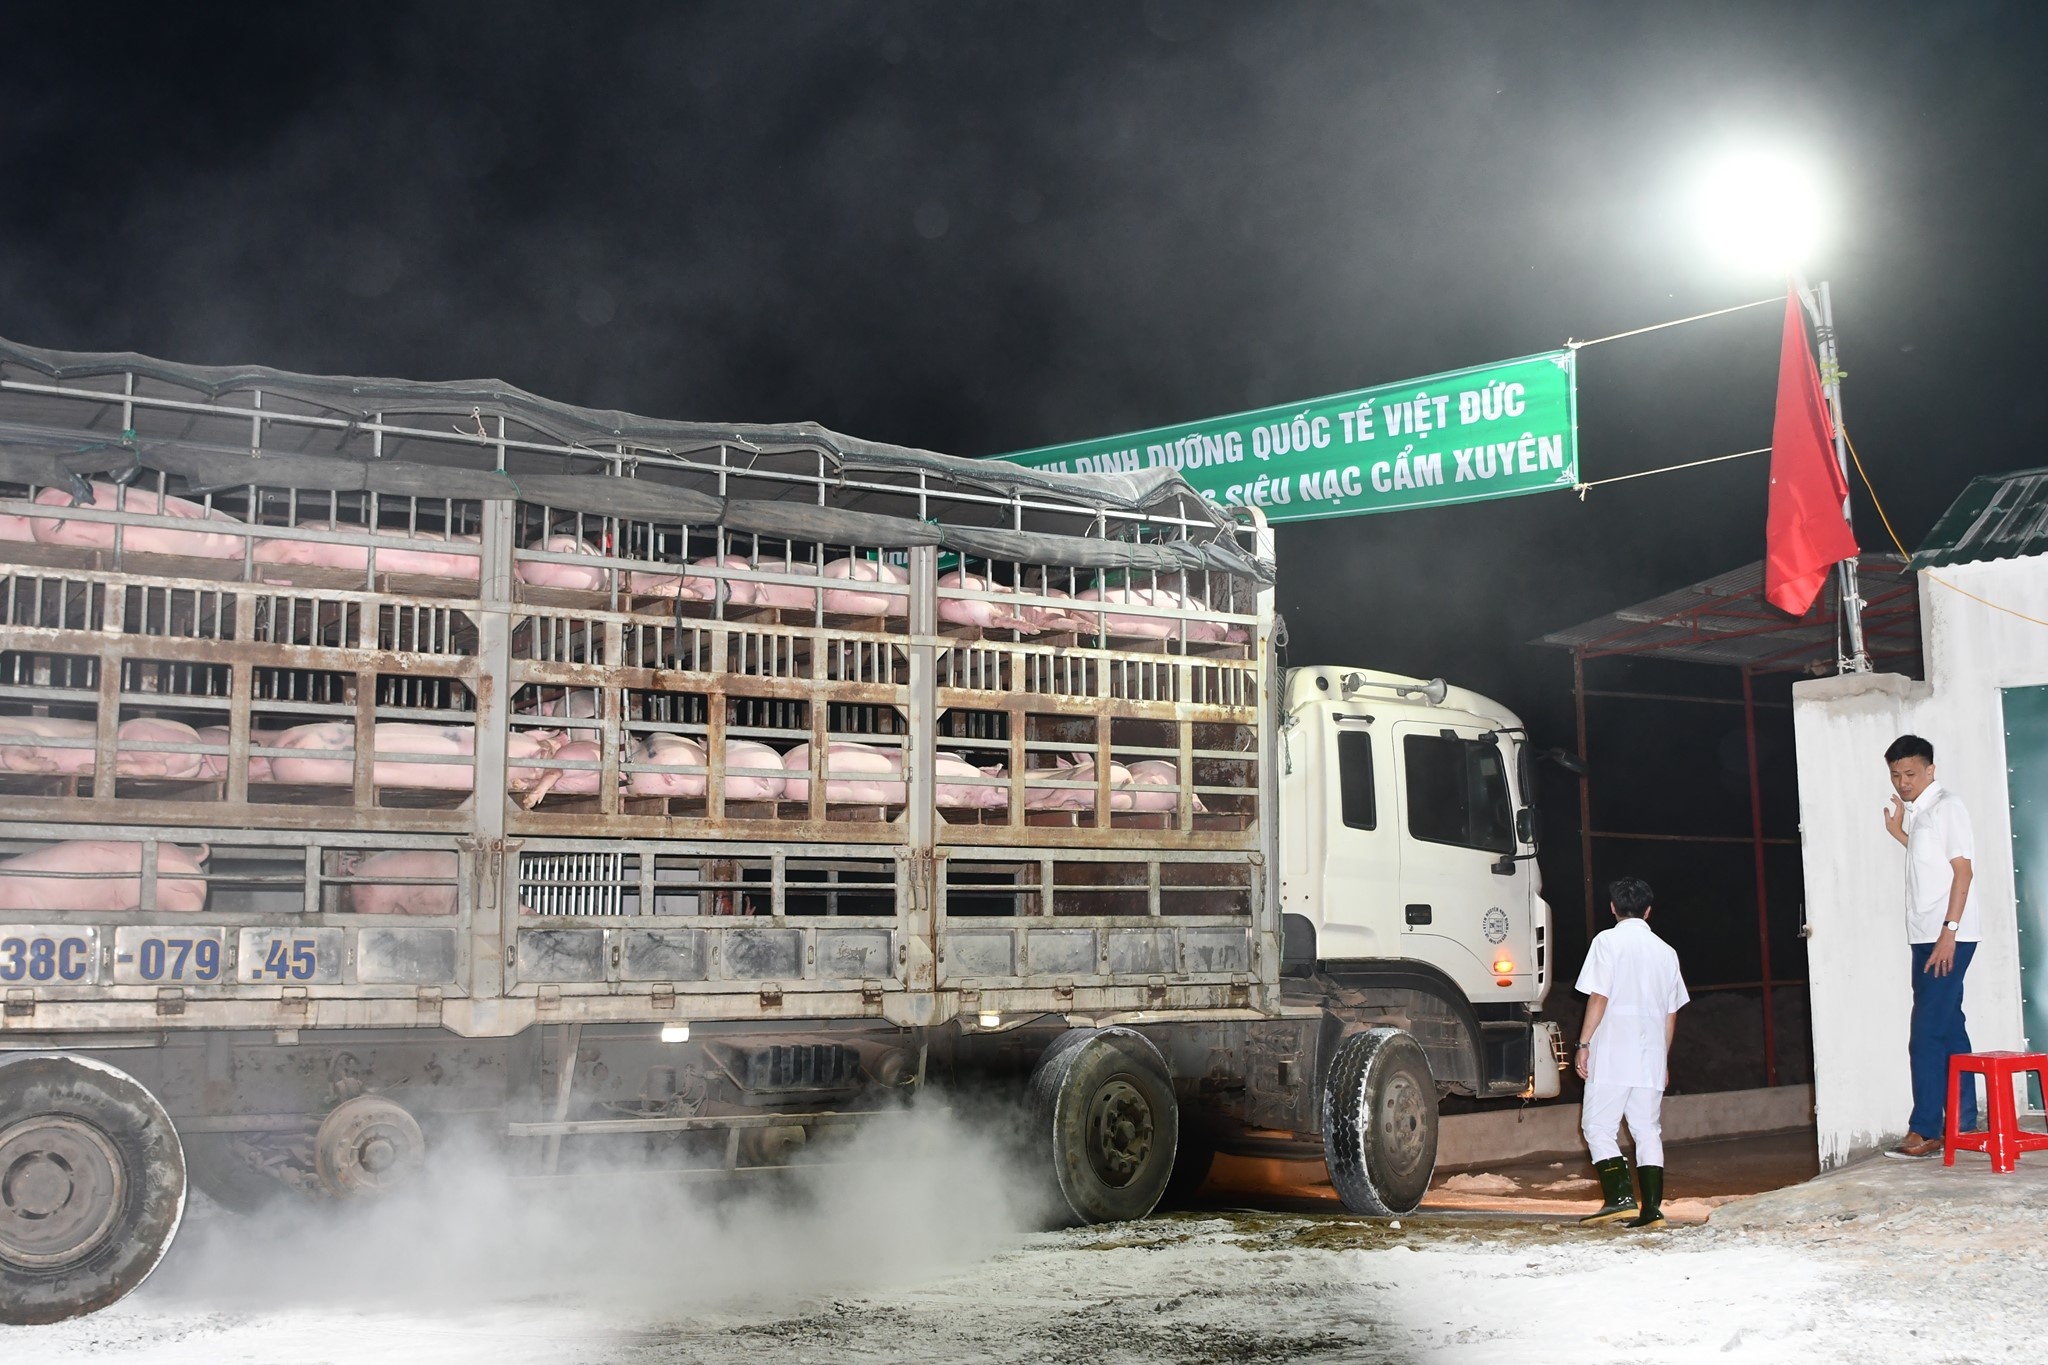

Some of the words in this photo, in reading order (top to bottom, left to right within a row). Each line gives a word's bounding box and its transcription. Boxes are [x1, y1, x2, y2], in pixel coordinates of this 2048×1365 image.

[1147, 430, 1243, 471] DƯỠNG
[1252, 408, 1331, 460] QUỐC
[1338, 397, 1376, 444] TẾ
[1383, 391, 1450, 439] VIỆT
[1459, 380, 1526, 425] ĐỨC
[1224, 474, 1292, 508] SIÊU
[1299, 465, 1363, 505] NẠC
[1370, 444, 1445, 493] CẨM
[1452, 432, 1564, 483] XUYÊN
[2, 937, 87, 981] 38C
